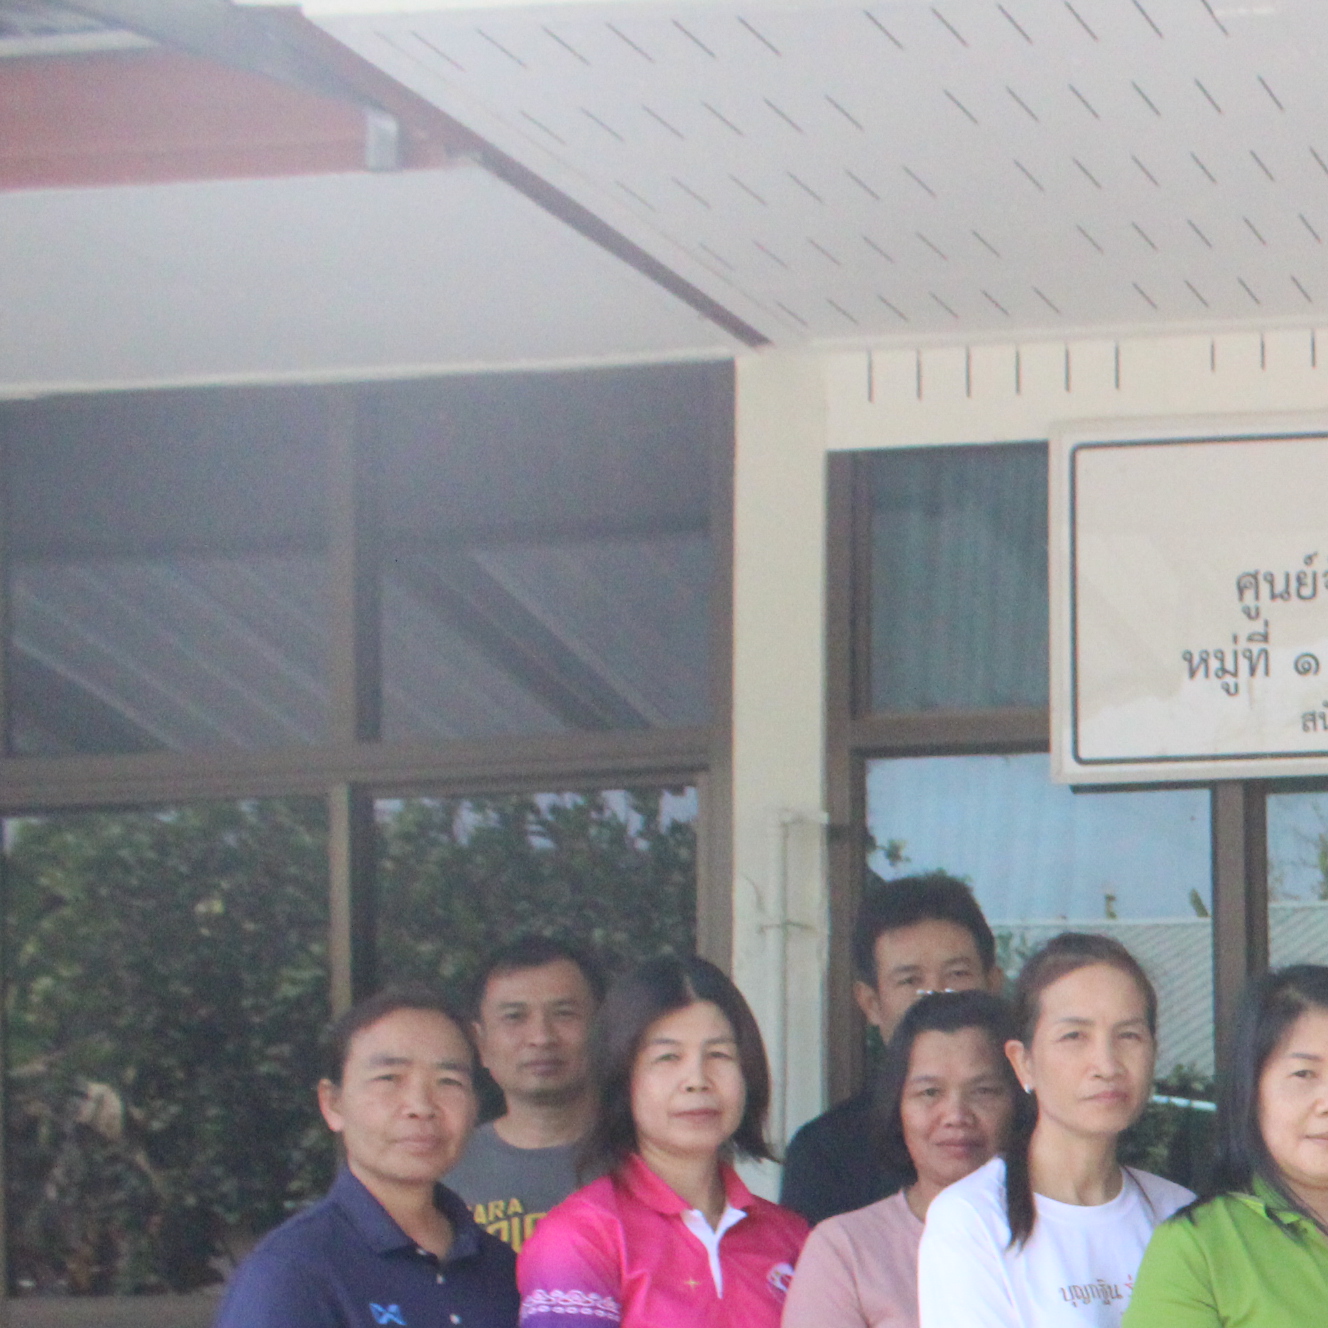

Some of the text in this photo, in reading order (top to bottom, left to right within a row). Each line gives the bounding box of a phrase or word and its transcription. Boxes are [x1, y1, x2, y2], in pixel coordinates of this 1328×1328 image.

[1181, 620, 1271, 697] หมู่ที่
[1293, 650, 1321, 676] ๑
[466, 1198, 523, 1225] ARA
